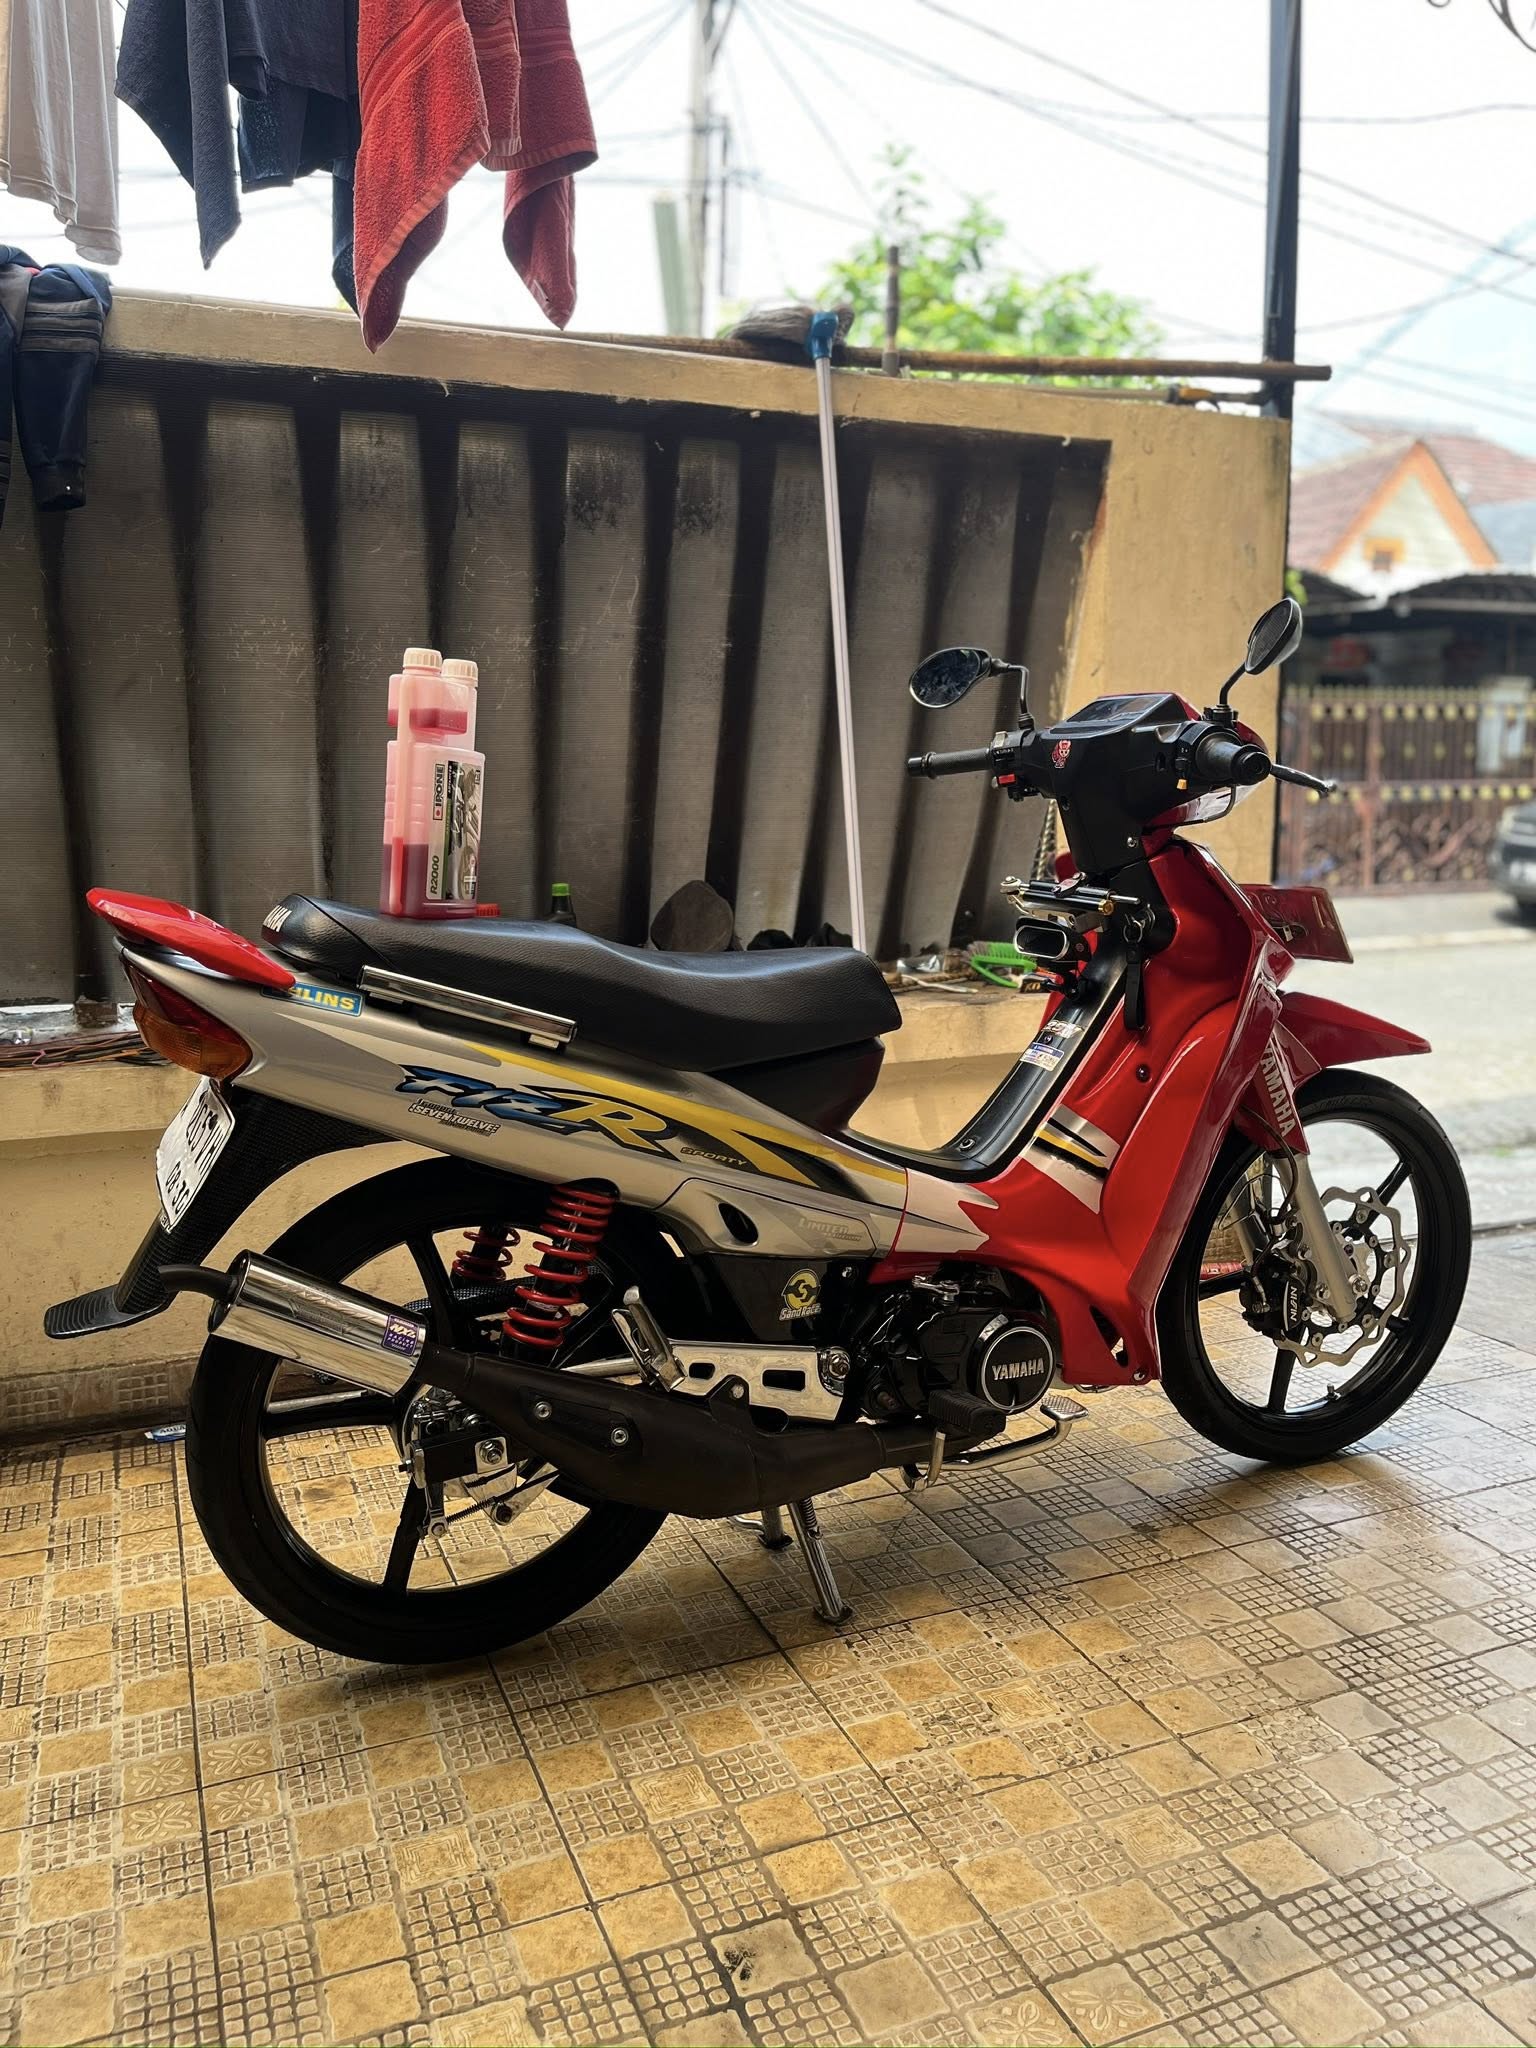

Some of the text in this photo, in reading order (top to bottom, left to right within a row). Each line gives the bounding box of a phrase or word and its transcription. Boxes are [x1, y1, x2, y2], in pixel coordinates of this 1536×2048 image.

[430, 855, 440, 895] R2000
[680, 1146, 748, 1166] SPORTY
[991, 1358, 1044, 1380] YAMAHA
